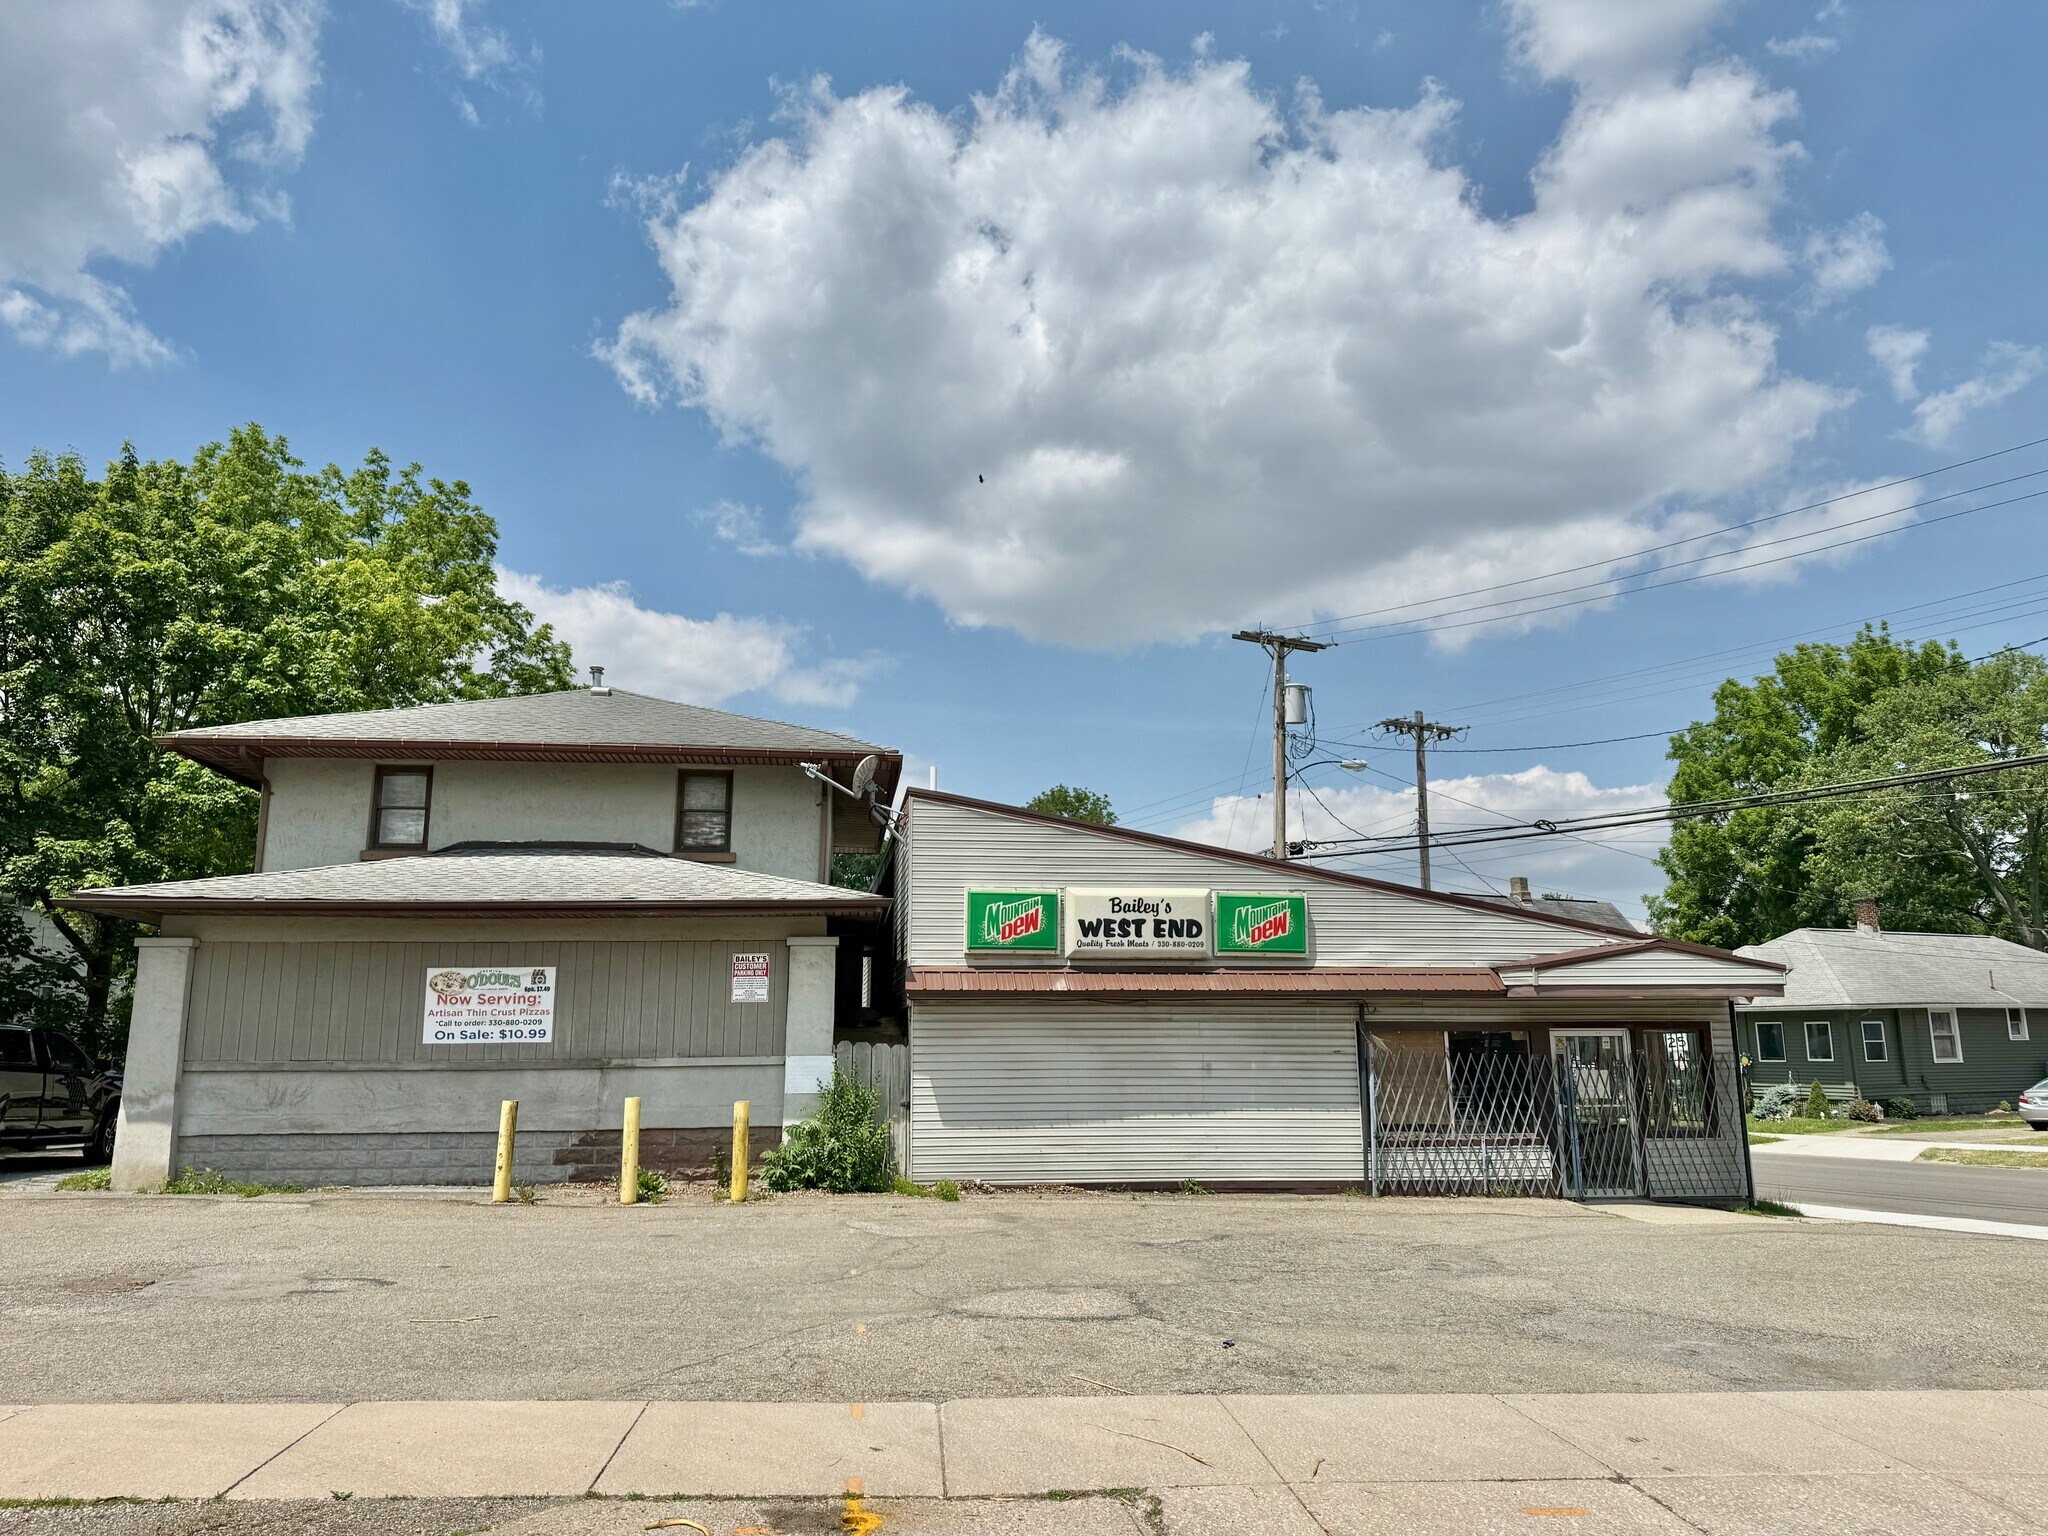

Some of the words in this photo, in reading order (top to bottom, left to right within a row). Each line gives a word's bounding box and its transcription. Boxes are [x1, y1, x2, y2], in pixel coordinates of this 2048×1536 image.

[1109, 897, 1172, 917] Bailey's
[1078, 918, 1146, 938] WEST
[1153, 918, 1203, 938] END
[1077, 939, 1103, 948] Quality
[1157, 940, 1205, 948] 330-880-0209
[437, 994, 472, 1005] Now
[477, 993, 541, 1006] Serving:
[428, 1009, 463, 1017] Artisan
[466, 1008, 487, 1016] Thin
[490, 1008, 516, 1016] Crust
[519, 1008, 550, 1016] Pizzas
[434, 1030, 455, 1040] On
[460, 1029, 494, 1040] Sale:
[499, 1029, 546, 1040] $10.99
